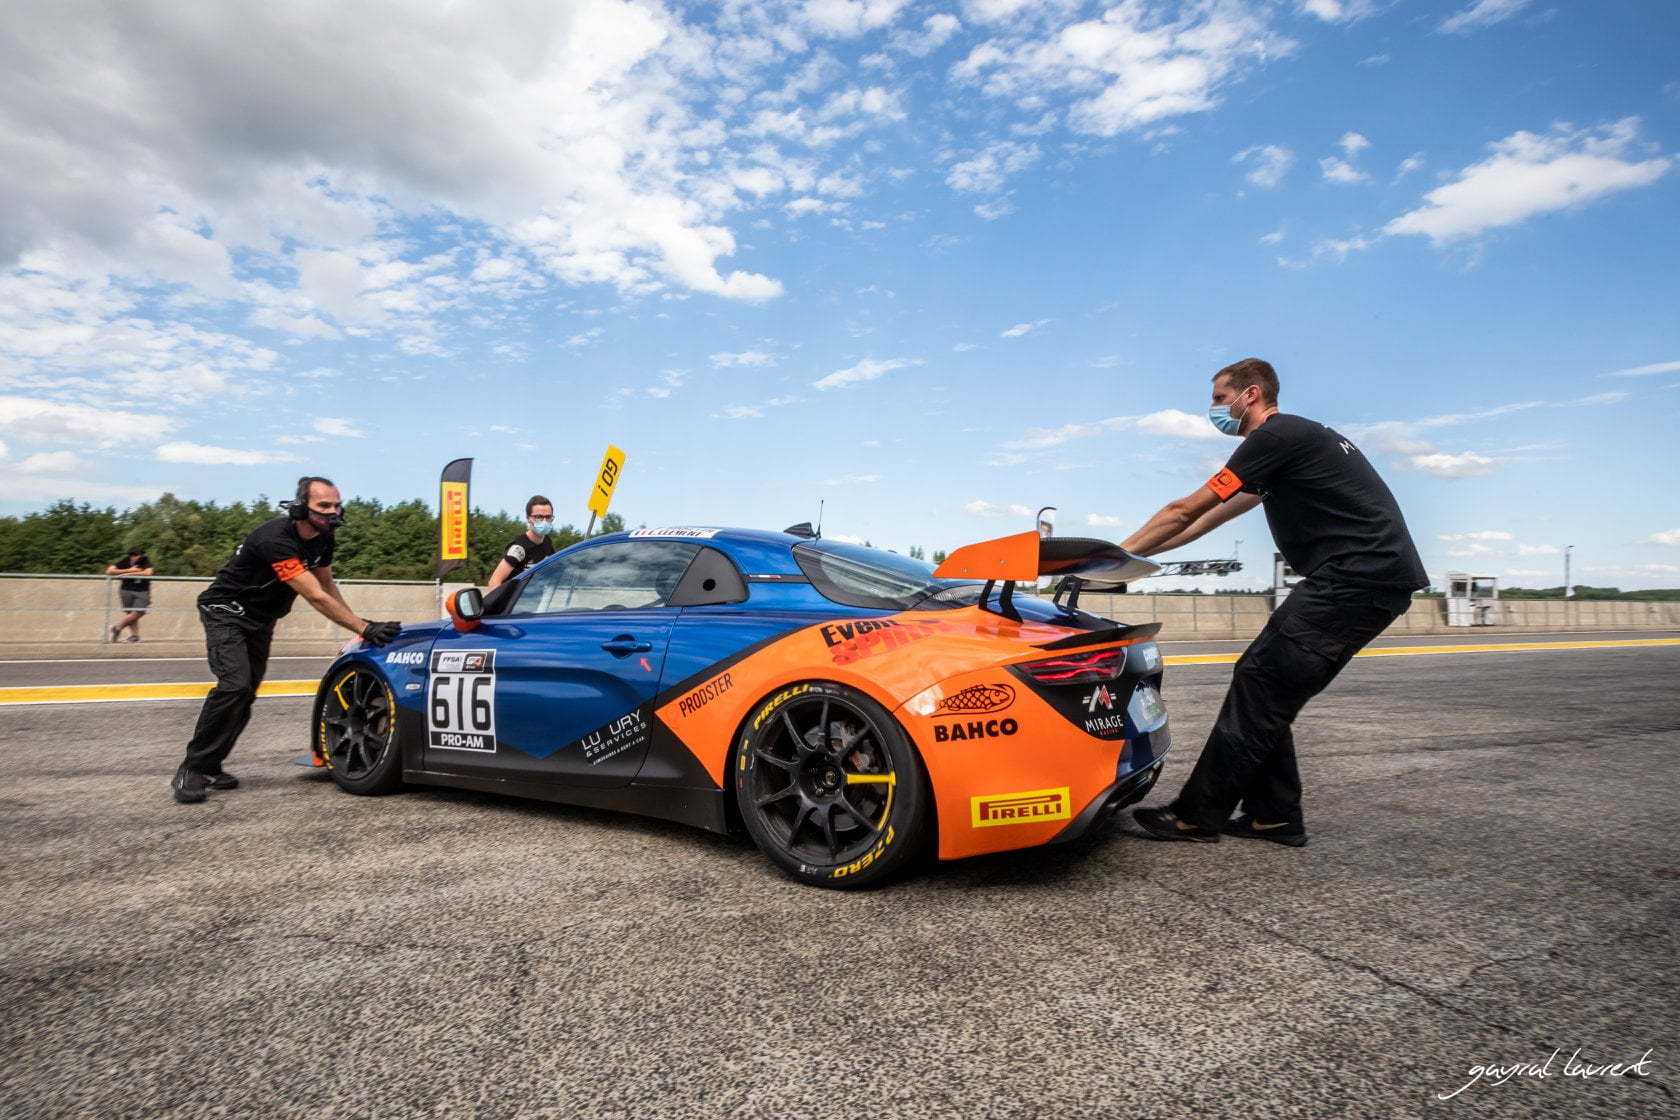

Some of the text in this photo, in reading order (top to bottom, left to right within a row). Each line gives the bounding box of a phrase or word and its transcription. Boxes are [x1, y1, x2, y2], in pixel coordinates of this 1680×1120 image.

[385, 652, 424, 665] BAHCO
[432, 677, 492, 731] 616
[754, 683, 810, 731] PIRELLI
[934, 718, 1018, 743] BAHCO
[1085, 714, 1124, 733] MIRAGE
[441, 733, 484, 749] PRO-AM
[979, 793, 1062, 821] PIRELLI
